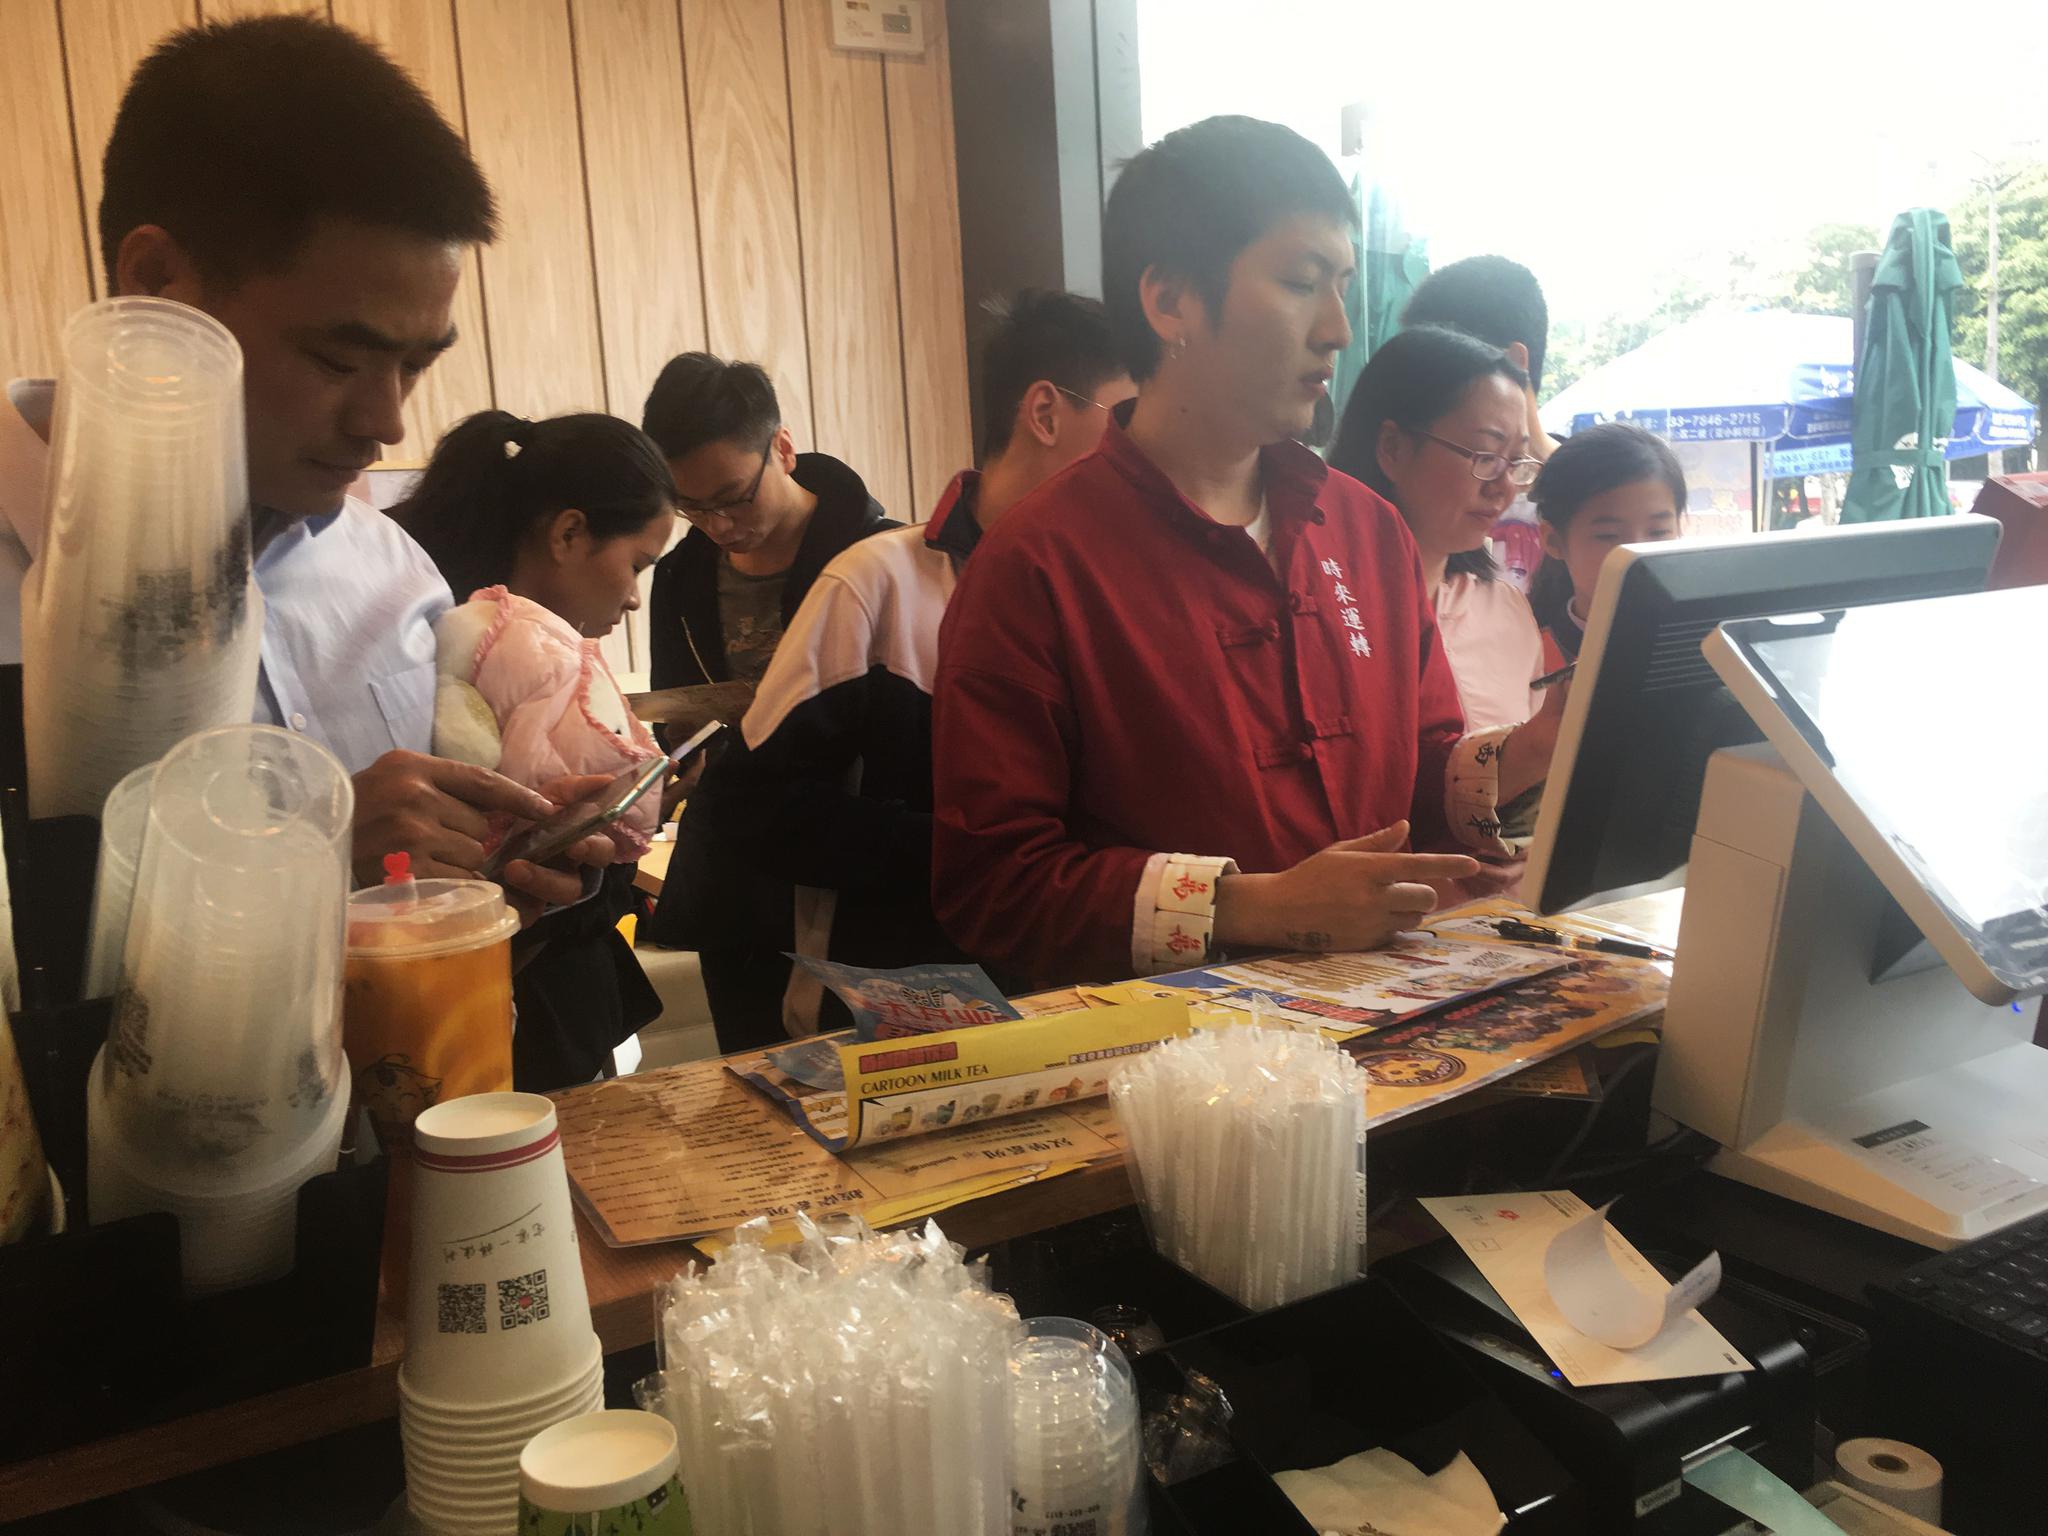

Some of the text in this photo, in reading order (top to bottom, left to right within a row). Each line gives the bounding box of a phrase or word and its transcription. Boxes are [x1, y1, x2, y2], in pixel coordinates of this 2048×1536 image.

[861, 1064, 990, 1095] CARTOON MILK TEA
